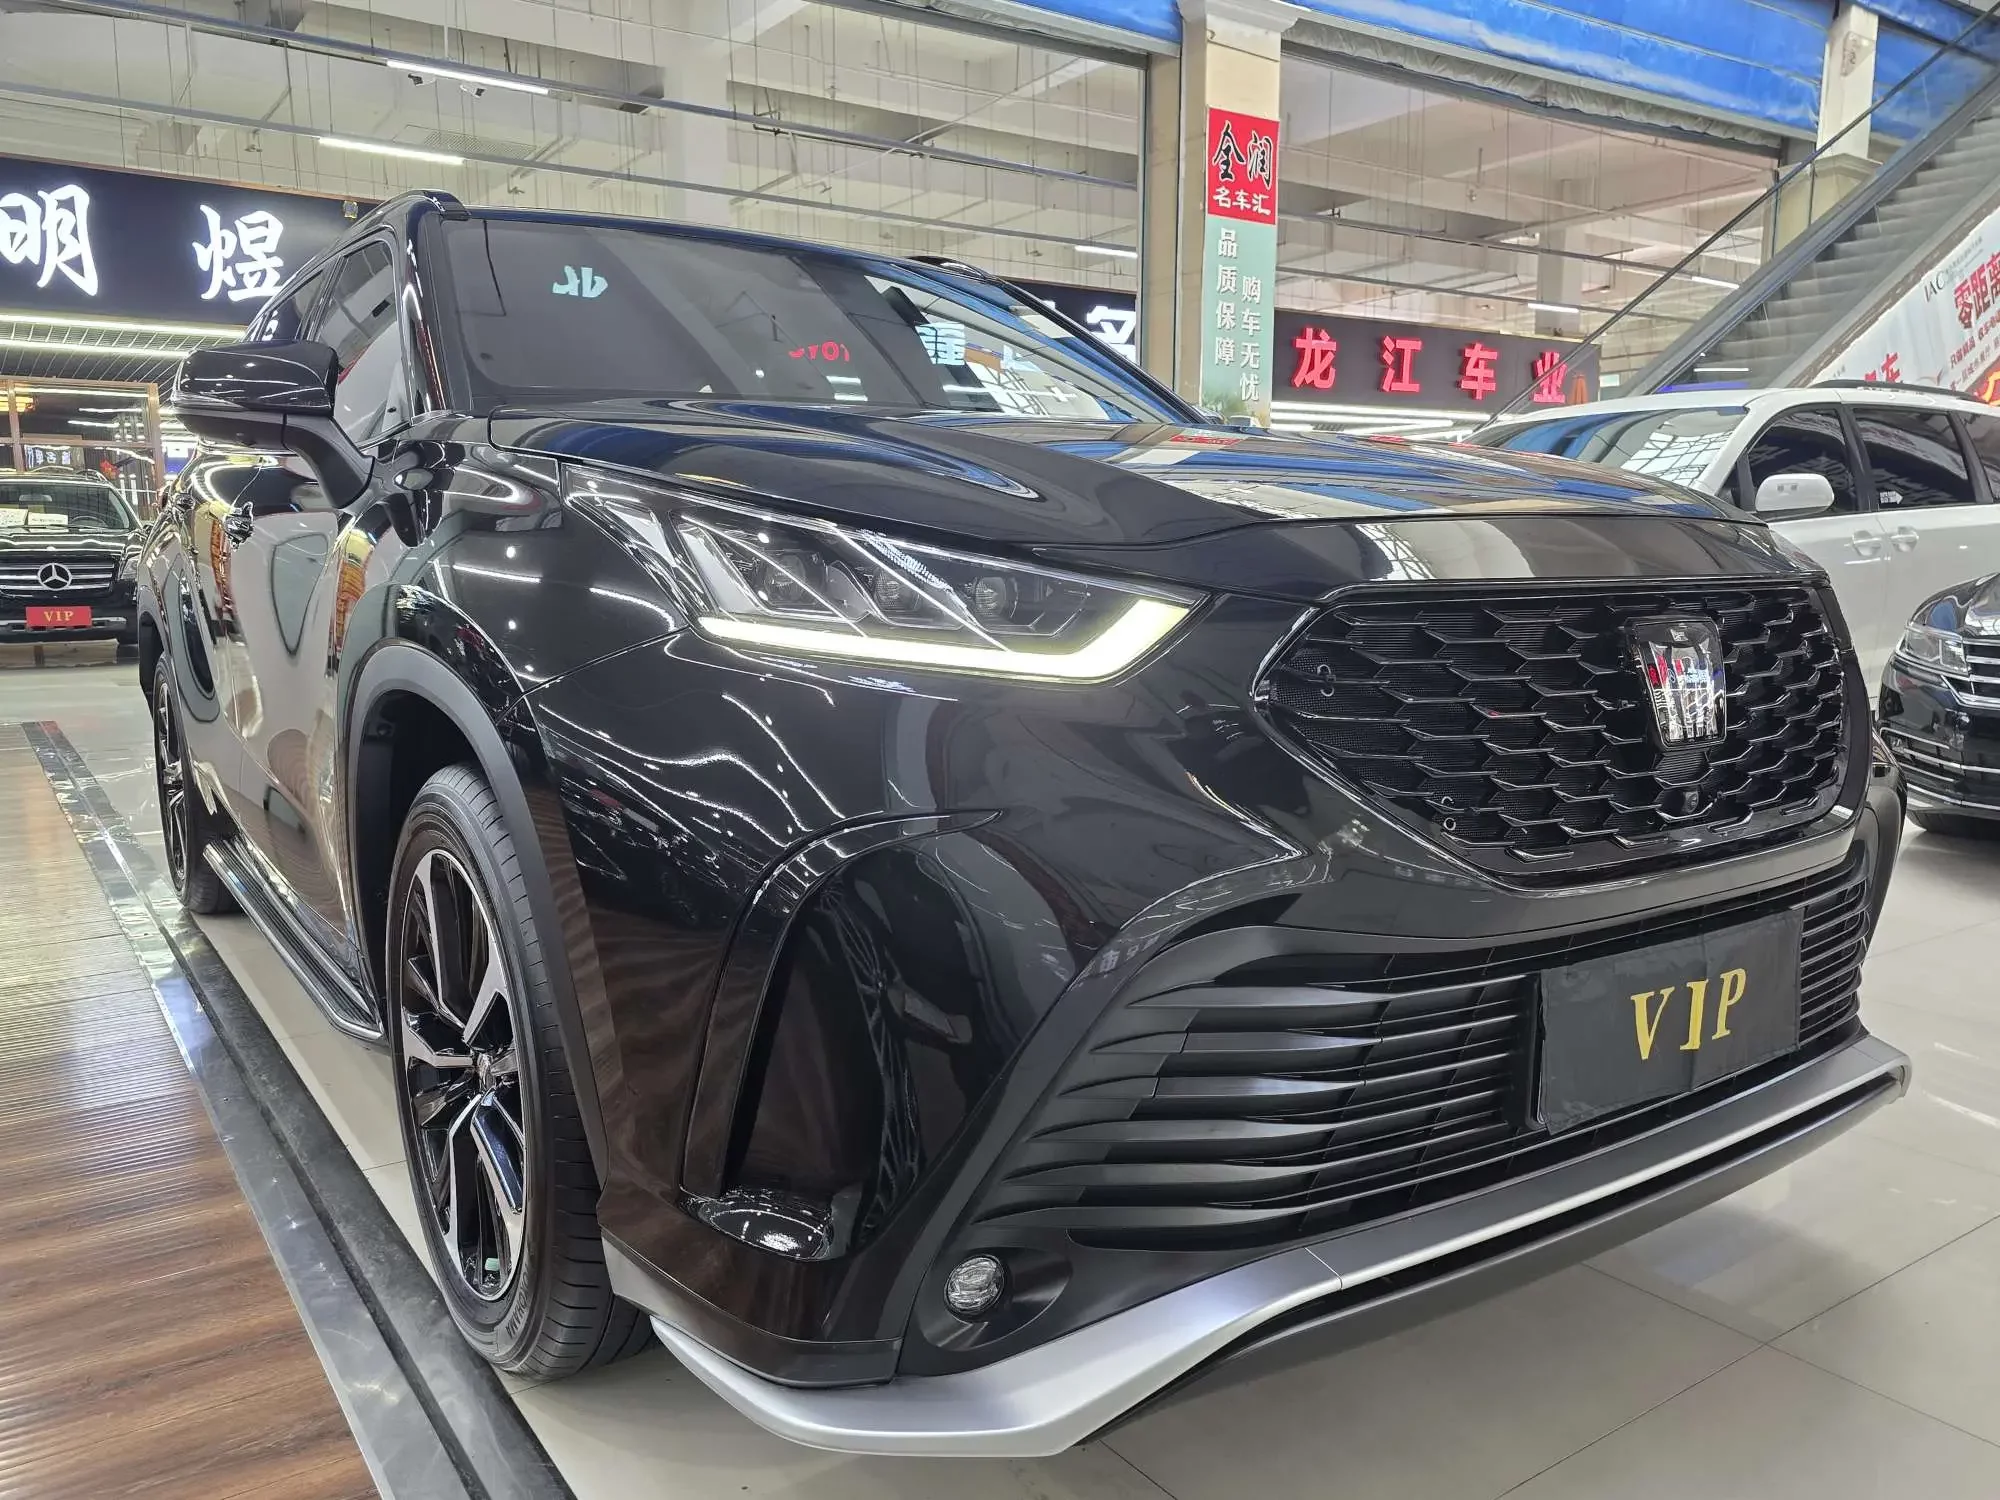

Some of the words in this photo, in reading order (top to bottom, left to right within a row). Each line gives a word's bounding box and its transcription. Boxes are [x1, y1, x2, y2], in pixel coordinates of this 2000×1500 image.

[1213, 186, 1271, 215] 名车汇
[1215, 227, 1238, 368] 品质保障
[1239, 275, 1262, 402] 购车无忧
[1293, 327, 1568, 404] 龙江车业
[43, 610, 74, 622] VIP
[1630, 968, 1747, 1060] VIP
